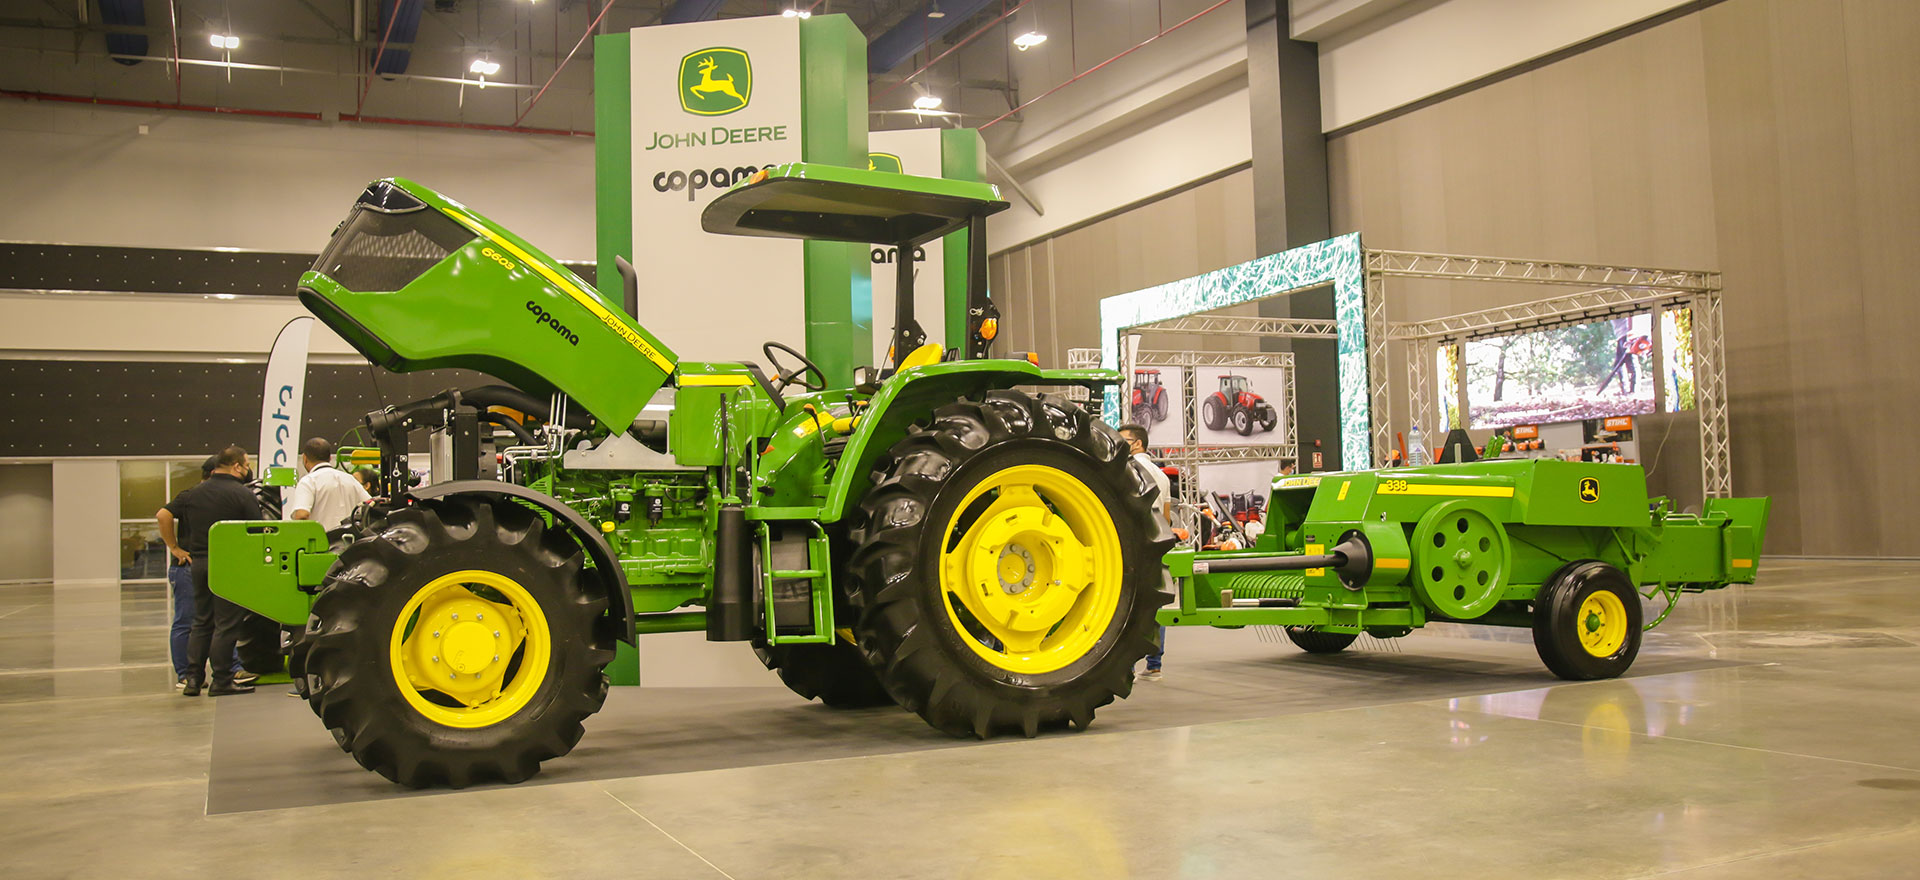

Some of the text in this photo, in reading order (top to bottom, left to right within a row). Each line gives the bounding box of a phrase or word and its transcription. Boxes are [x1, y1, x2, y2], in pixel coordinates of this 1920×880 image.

[645, 125, 787, 151] JOHN DEERE
[653, 164, 776, 202] copam
[481, 247, 516, 270] 6603
[525, 300, 579, 346] copama
[601, 314, 657, 360] JOHN DEERE
[1515, 426, 1534, 434] STIHL
[1606, 418, 1628, 427] STIHL
[270, 384, 293, 505] bota
[1281, 476, 1322, 487] JOHN DEE
[1386, 479, 1408, 491] 338
